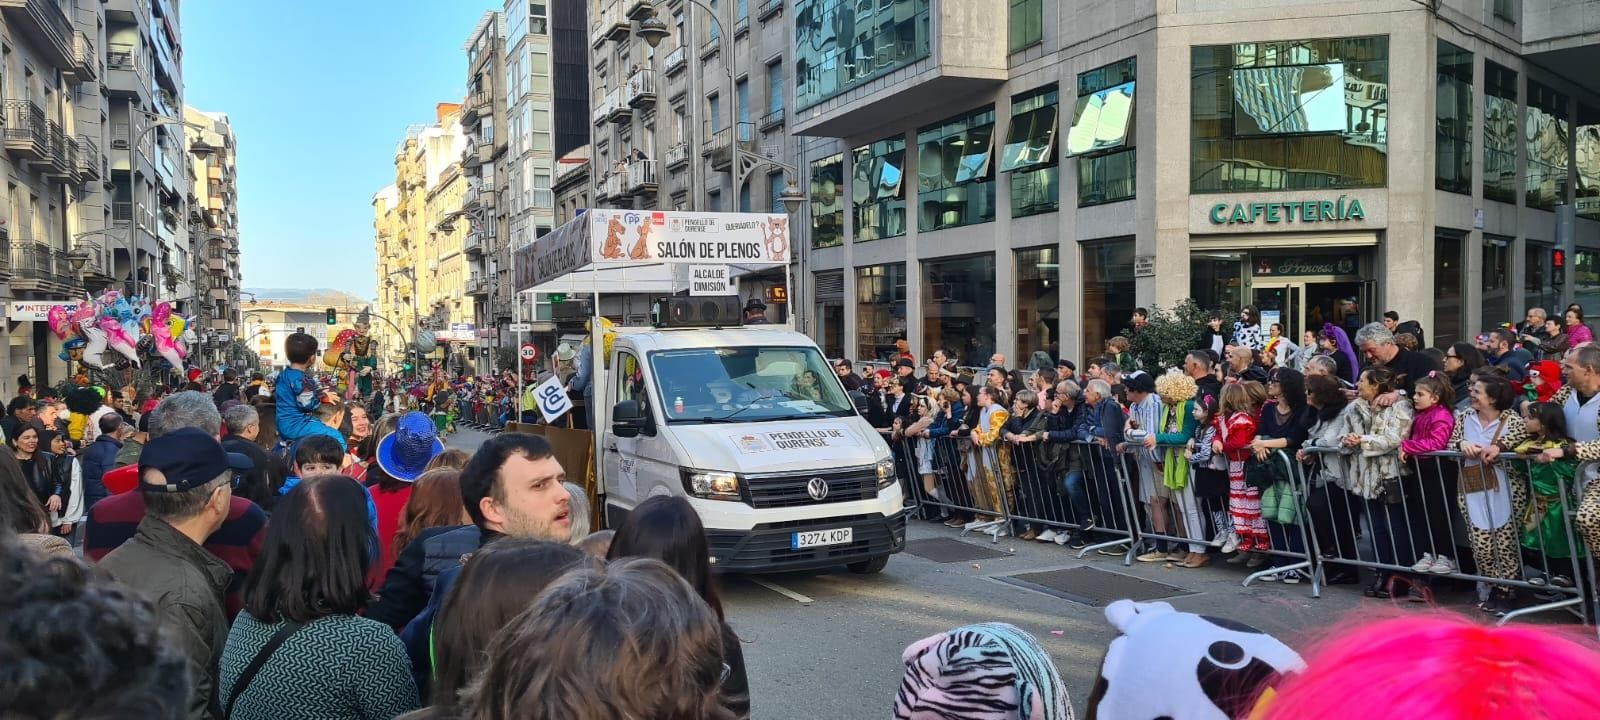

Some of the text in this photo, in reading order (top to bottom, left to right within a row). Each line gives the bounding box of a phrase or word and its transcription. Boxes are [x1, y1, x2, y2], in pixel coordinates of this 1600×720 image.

[1210, 195, 1365, 224] CAFETERÍA
[657, 238, 760, 259] SALÓN DE PLENOS
[1279, 257, 1334, 273] Princess
[694, 269, 725, 279] ALCALDE
[694, 281, 726, 292] DIMISIÓN
[769, 428, 844, 440] PENDELLO DE
[776, 438, 830, 449] OURENSE
[801, 529, 850, 546] 3274 KDP
